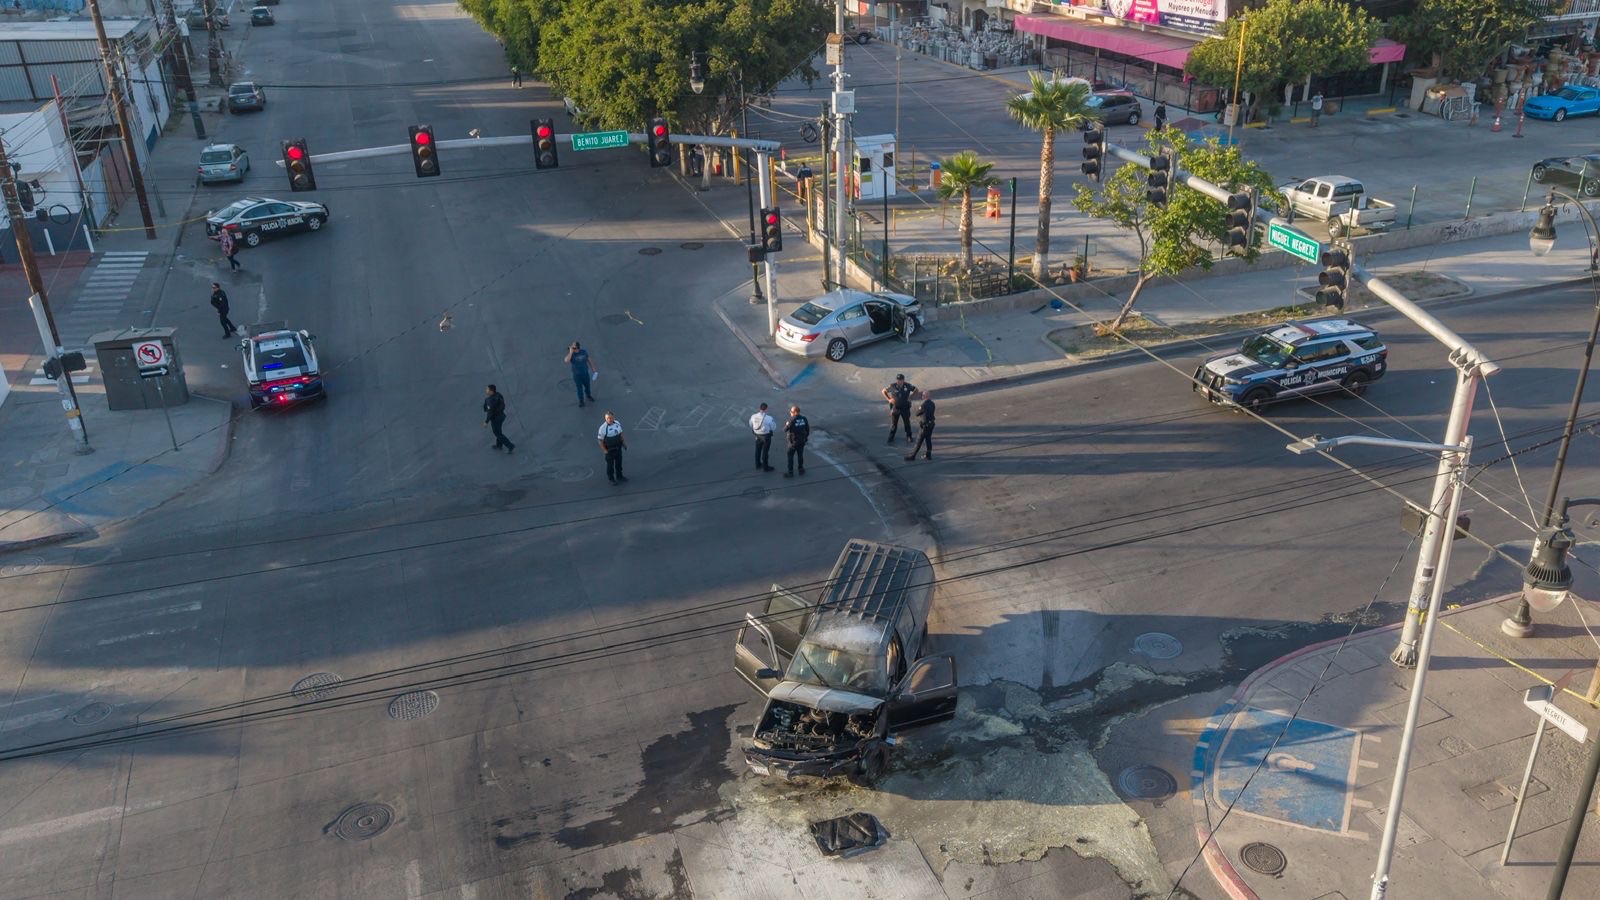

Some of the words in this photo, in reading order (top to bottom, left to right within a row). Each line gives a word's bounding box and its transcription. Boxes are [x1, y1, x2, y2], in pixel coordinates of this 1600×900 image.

[1168, 2, 1189, 12] Mayoreo
[1195, 6, 1218, 16] Menudeo
[577, 136, 599, 147] BENITO
[601, 134, 623, 144] JUAREZ
[1271, 228, 1290, 248] MIGUEL
[1292, 238, 1315, 258] NEGRETE
[1318, 366, 1348, 378] MUNICIPAL
[1543, 706, 1566, 726] NEGRETE
